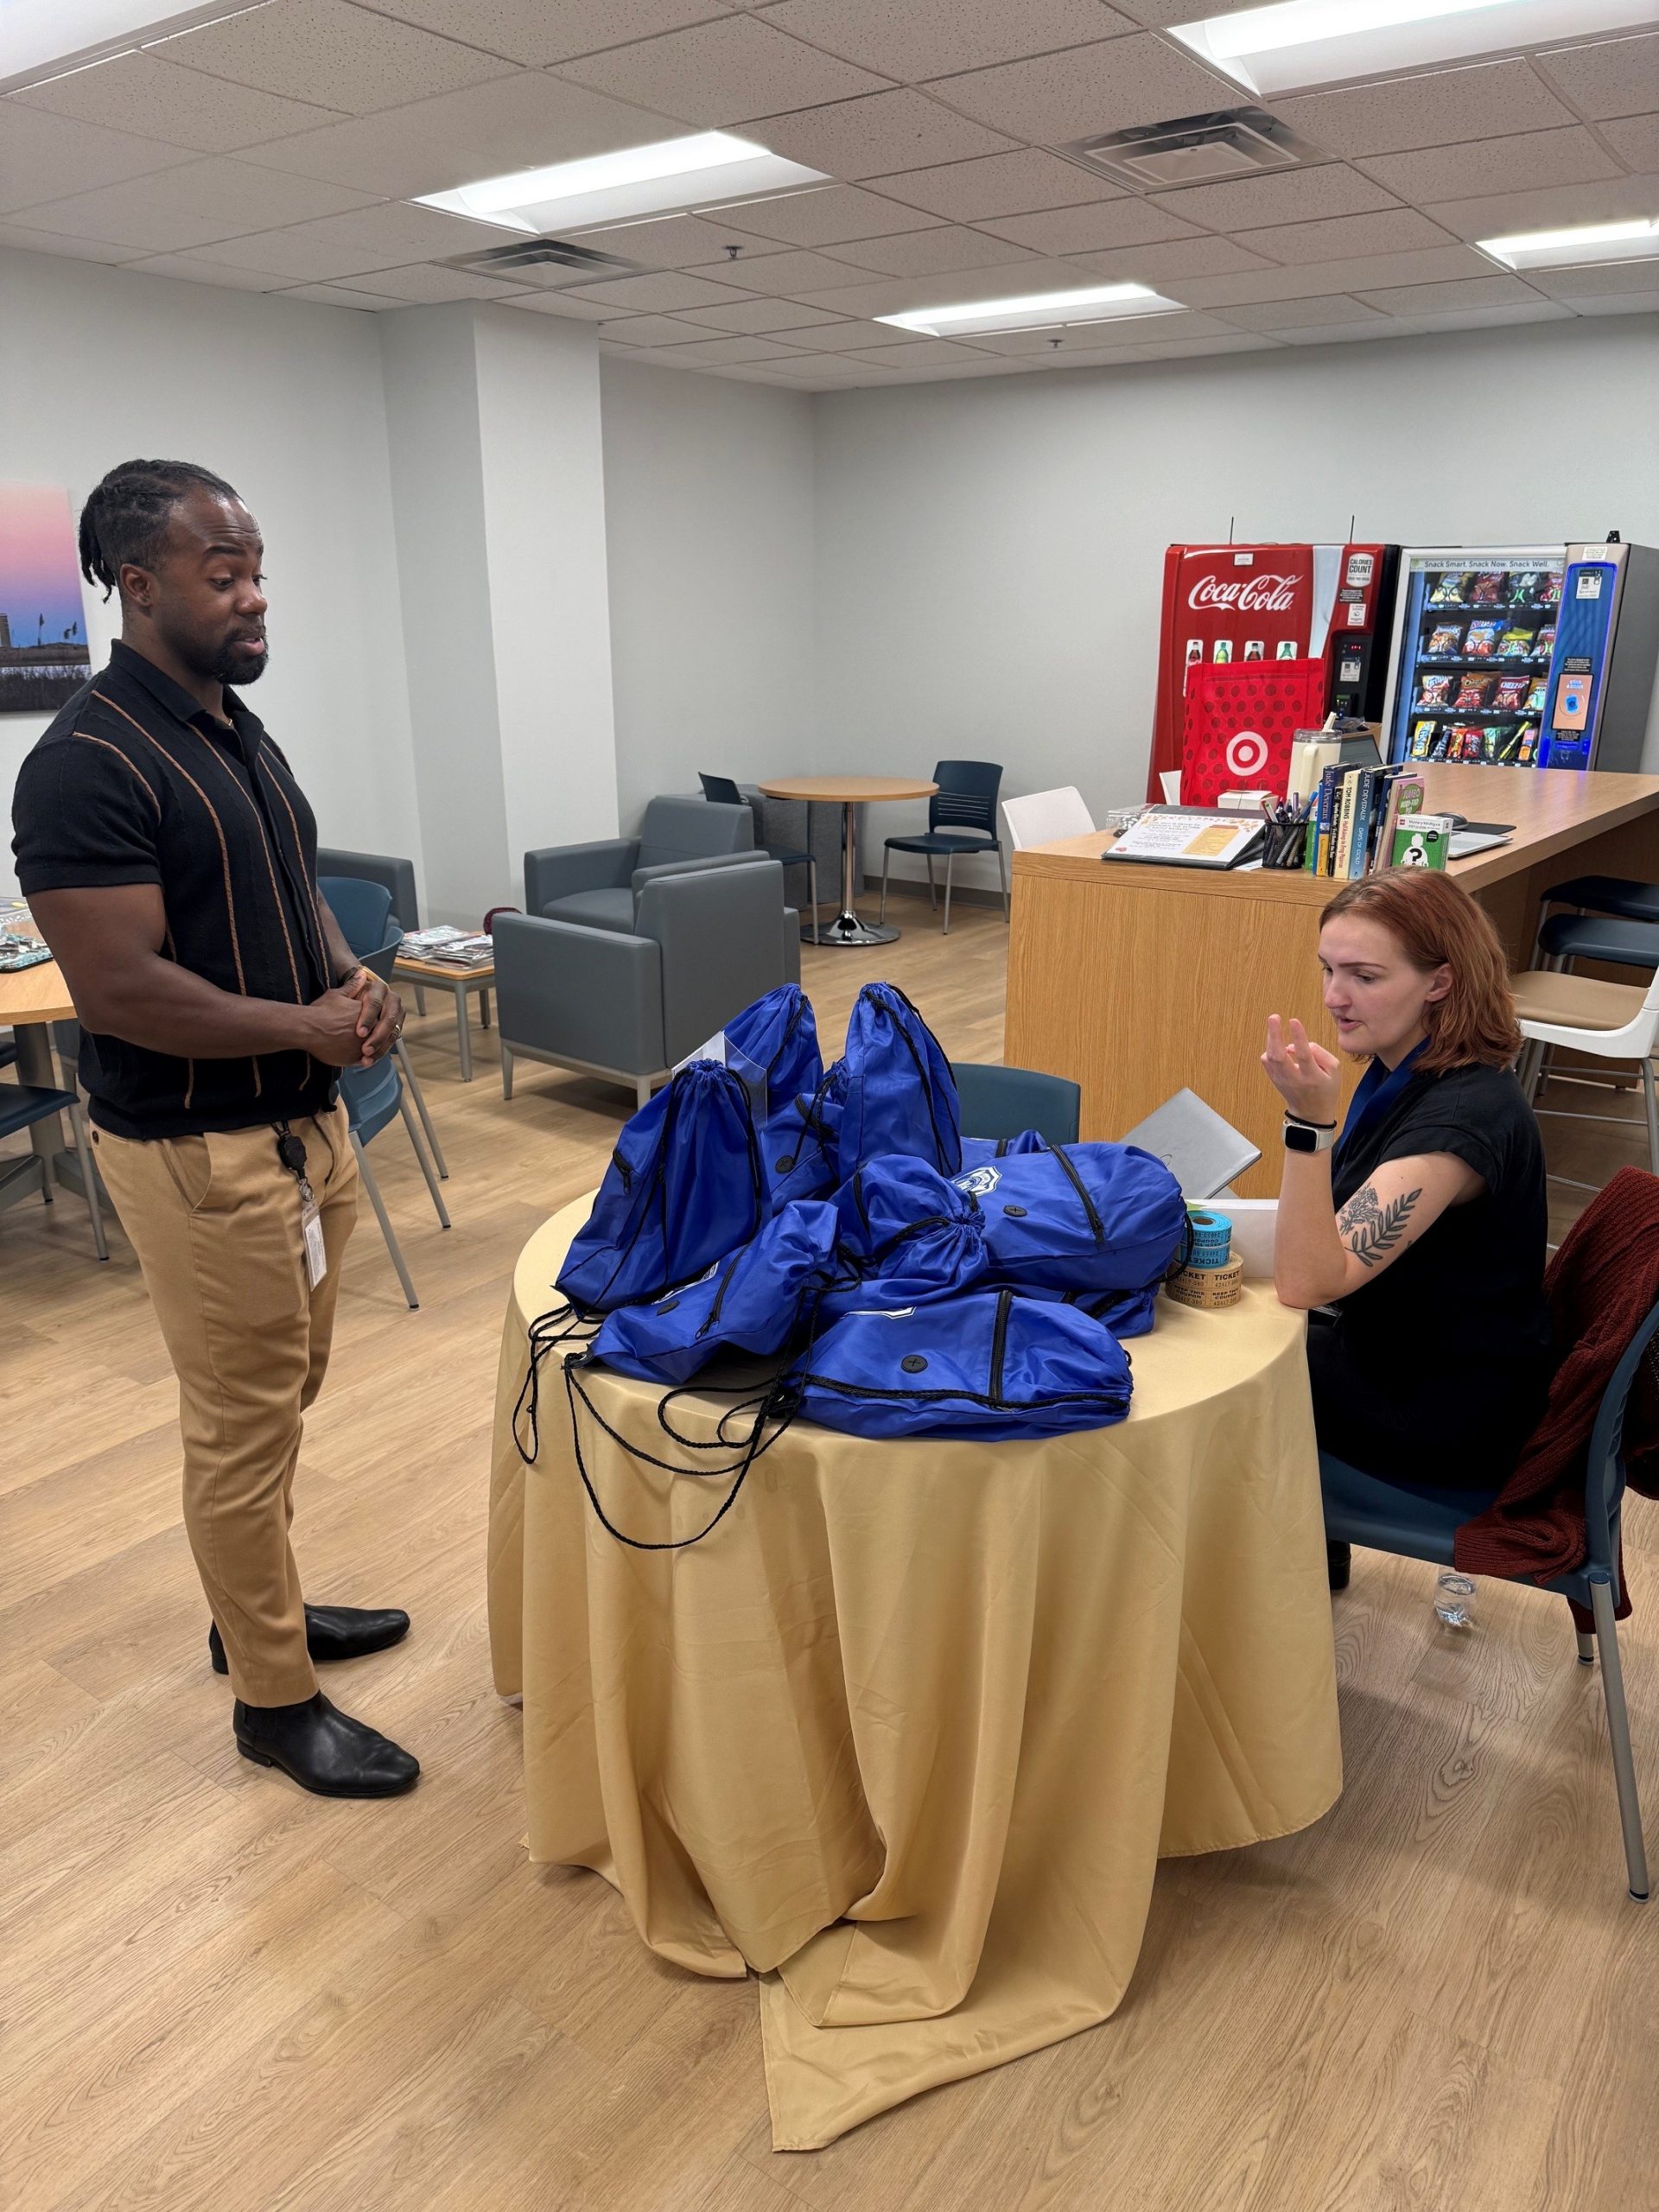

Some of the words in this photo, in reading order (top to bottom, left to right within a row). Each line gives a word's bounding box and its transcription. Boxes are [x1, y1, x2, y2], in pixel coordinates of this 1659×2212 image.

[1349, 565, 1371, 574] COUNT
[1188, 575, 1305, 611] Coca-Cola
[1323, 788, 1332, 819] Deveraux
[1360, 790, 1369, 821] DEVERAUX
[1214, 1270, 1239, 1281] TICKET
